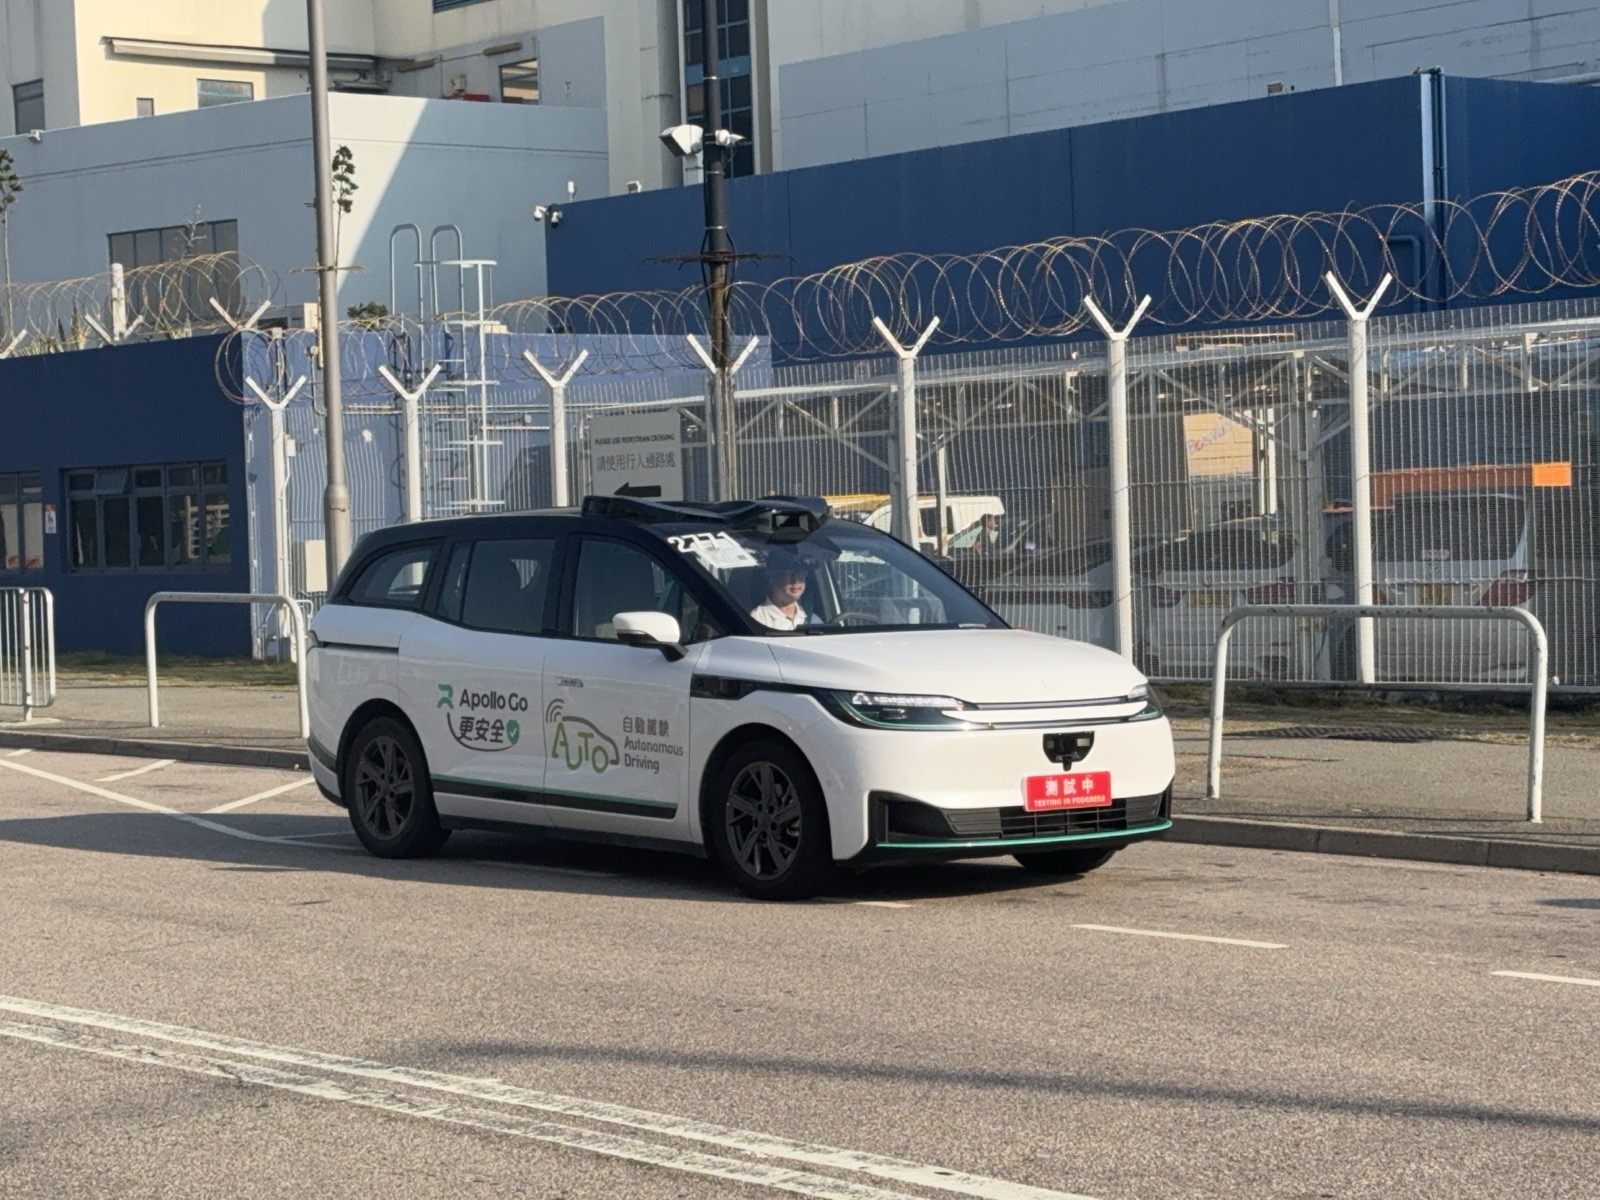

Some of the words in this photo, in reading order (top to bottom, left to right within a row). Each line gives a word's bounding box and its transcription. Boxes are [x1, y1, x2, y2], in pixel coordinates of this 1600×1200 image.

[595, 437, 611, 445] PLEASE
[612, 436, 621, 444] USE
[622, 435, 650, 444] PEDESTRIAN
[651, 434, 675, 442] CROSSING
[597, 451, 676, 471] 請使用行人過路處
[459, 688, 506, 711] Apollo
[508, 692, 528, 712] Go
[459, 716, 505, 744] 更安全
[623, 716, 669, 738] 自動駕駛
[624, 736, 684, 756] Autonomous
[624, 756, 660, 774] Driving
[1045, 777, 1094, 796] 測試中
[1034, 798, 1062, 807] TESTING
[1072, 795, 1106, 804] PROGRESS
